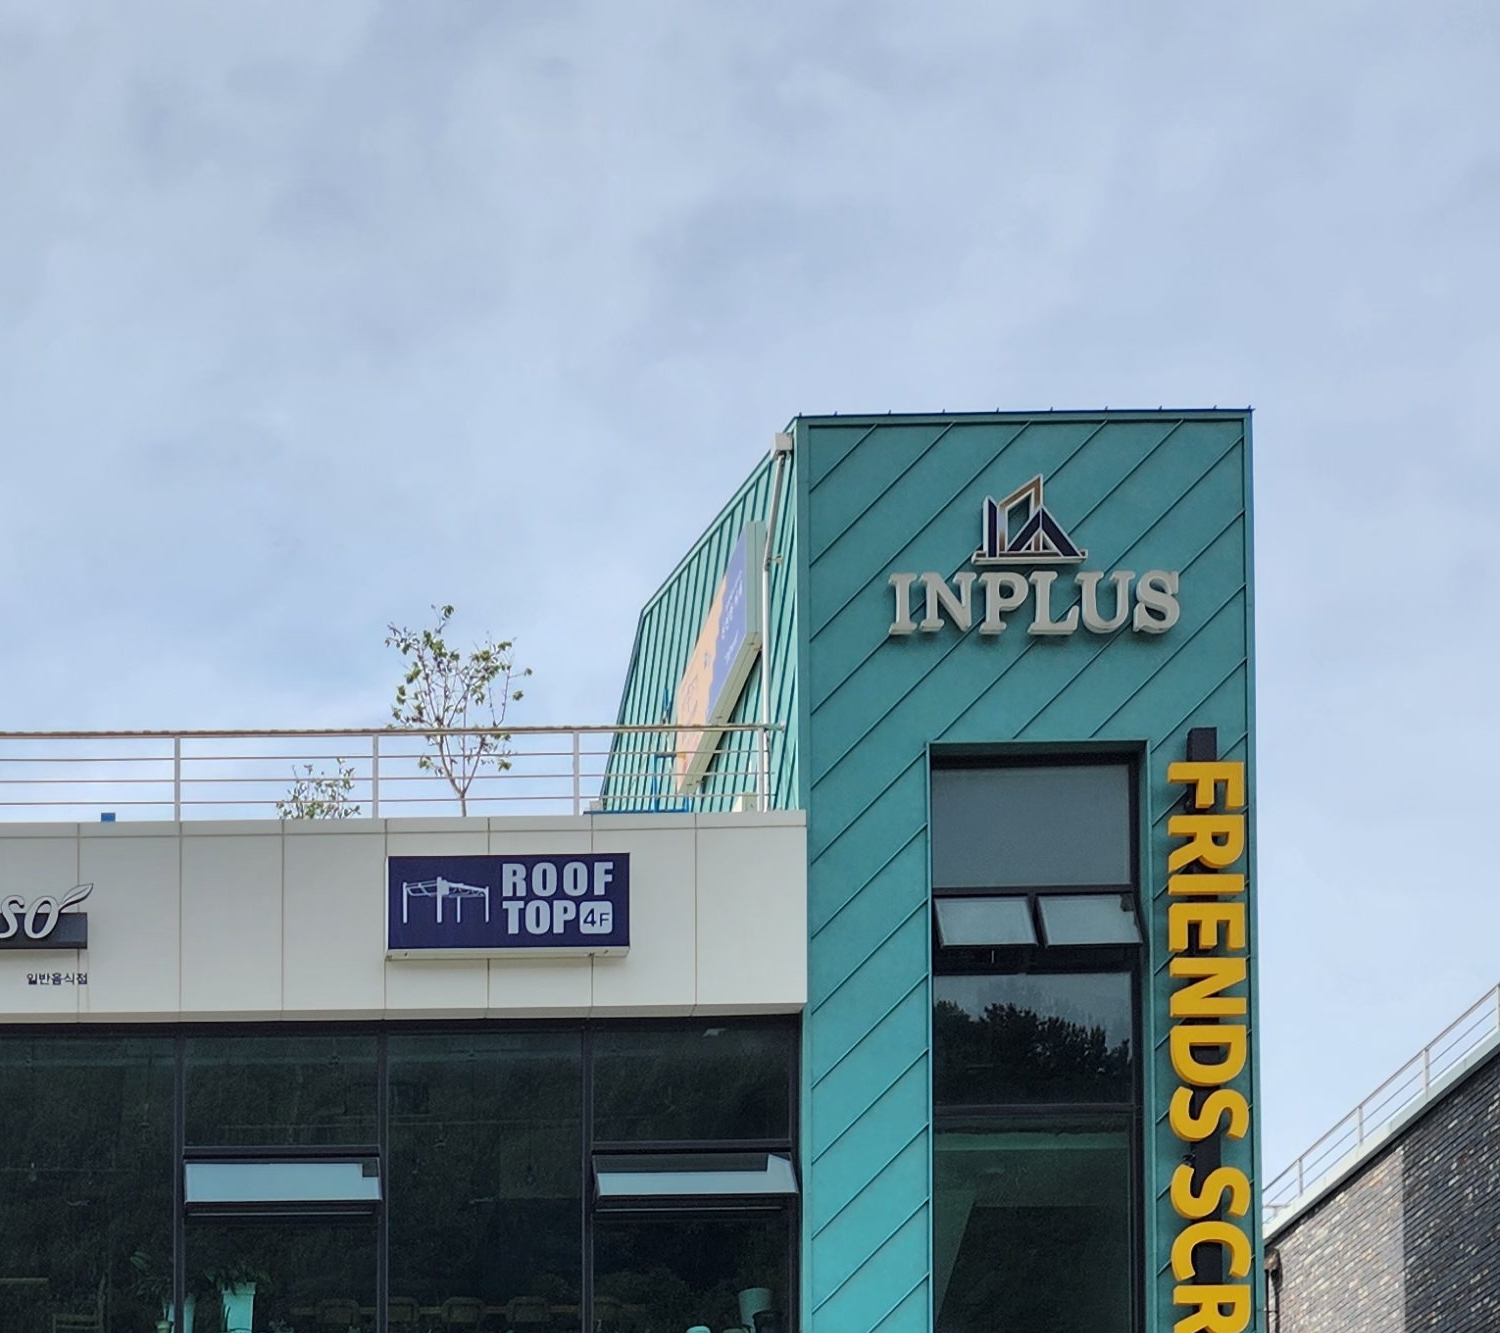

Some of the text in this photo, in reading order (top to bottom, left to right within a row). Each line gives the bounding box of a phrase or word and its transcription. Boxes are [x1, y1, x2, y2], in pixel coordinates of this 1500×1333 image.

[887, 569, 1181, 637] INPLUS
[501, 861, 614, 898] ROOF
[501, 899, 612, 936] TOP 4F
[1167, 760, 1249, 1144] FRIENDS
[26, 971, 89, 987] 일반음식점
